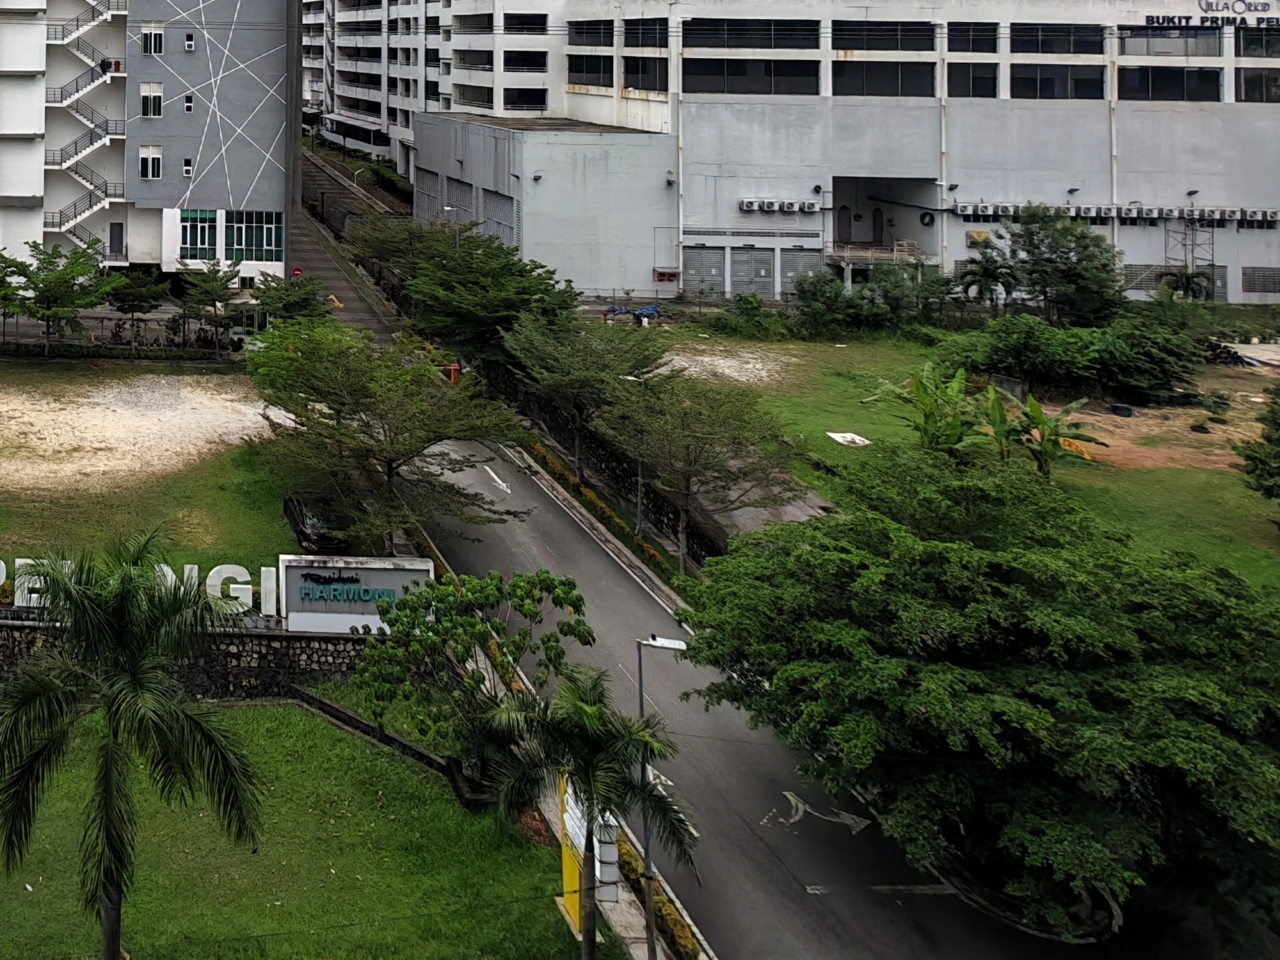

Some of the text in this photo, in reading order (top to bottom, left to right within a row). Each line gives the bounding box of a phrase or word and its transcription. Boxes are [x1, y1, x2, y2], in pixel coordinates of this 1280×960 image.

[1145, 15, 1193, 26] BUKIT
[1200, 16, 1248, 28] PRIMA
[299, 585, 396, 602] HARMONI
